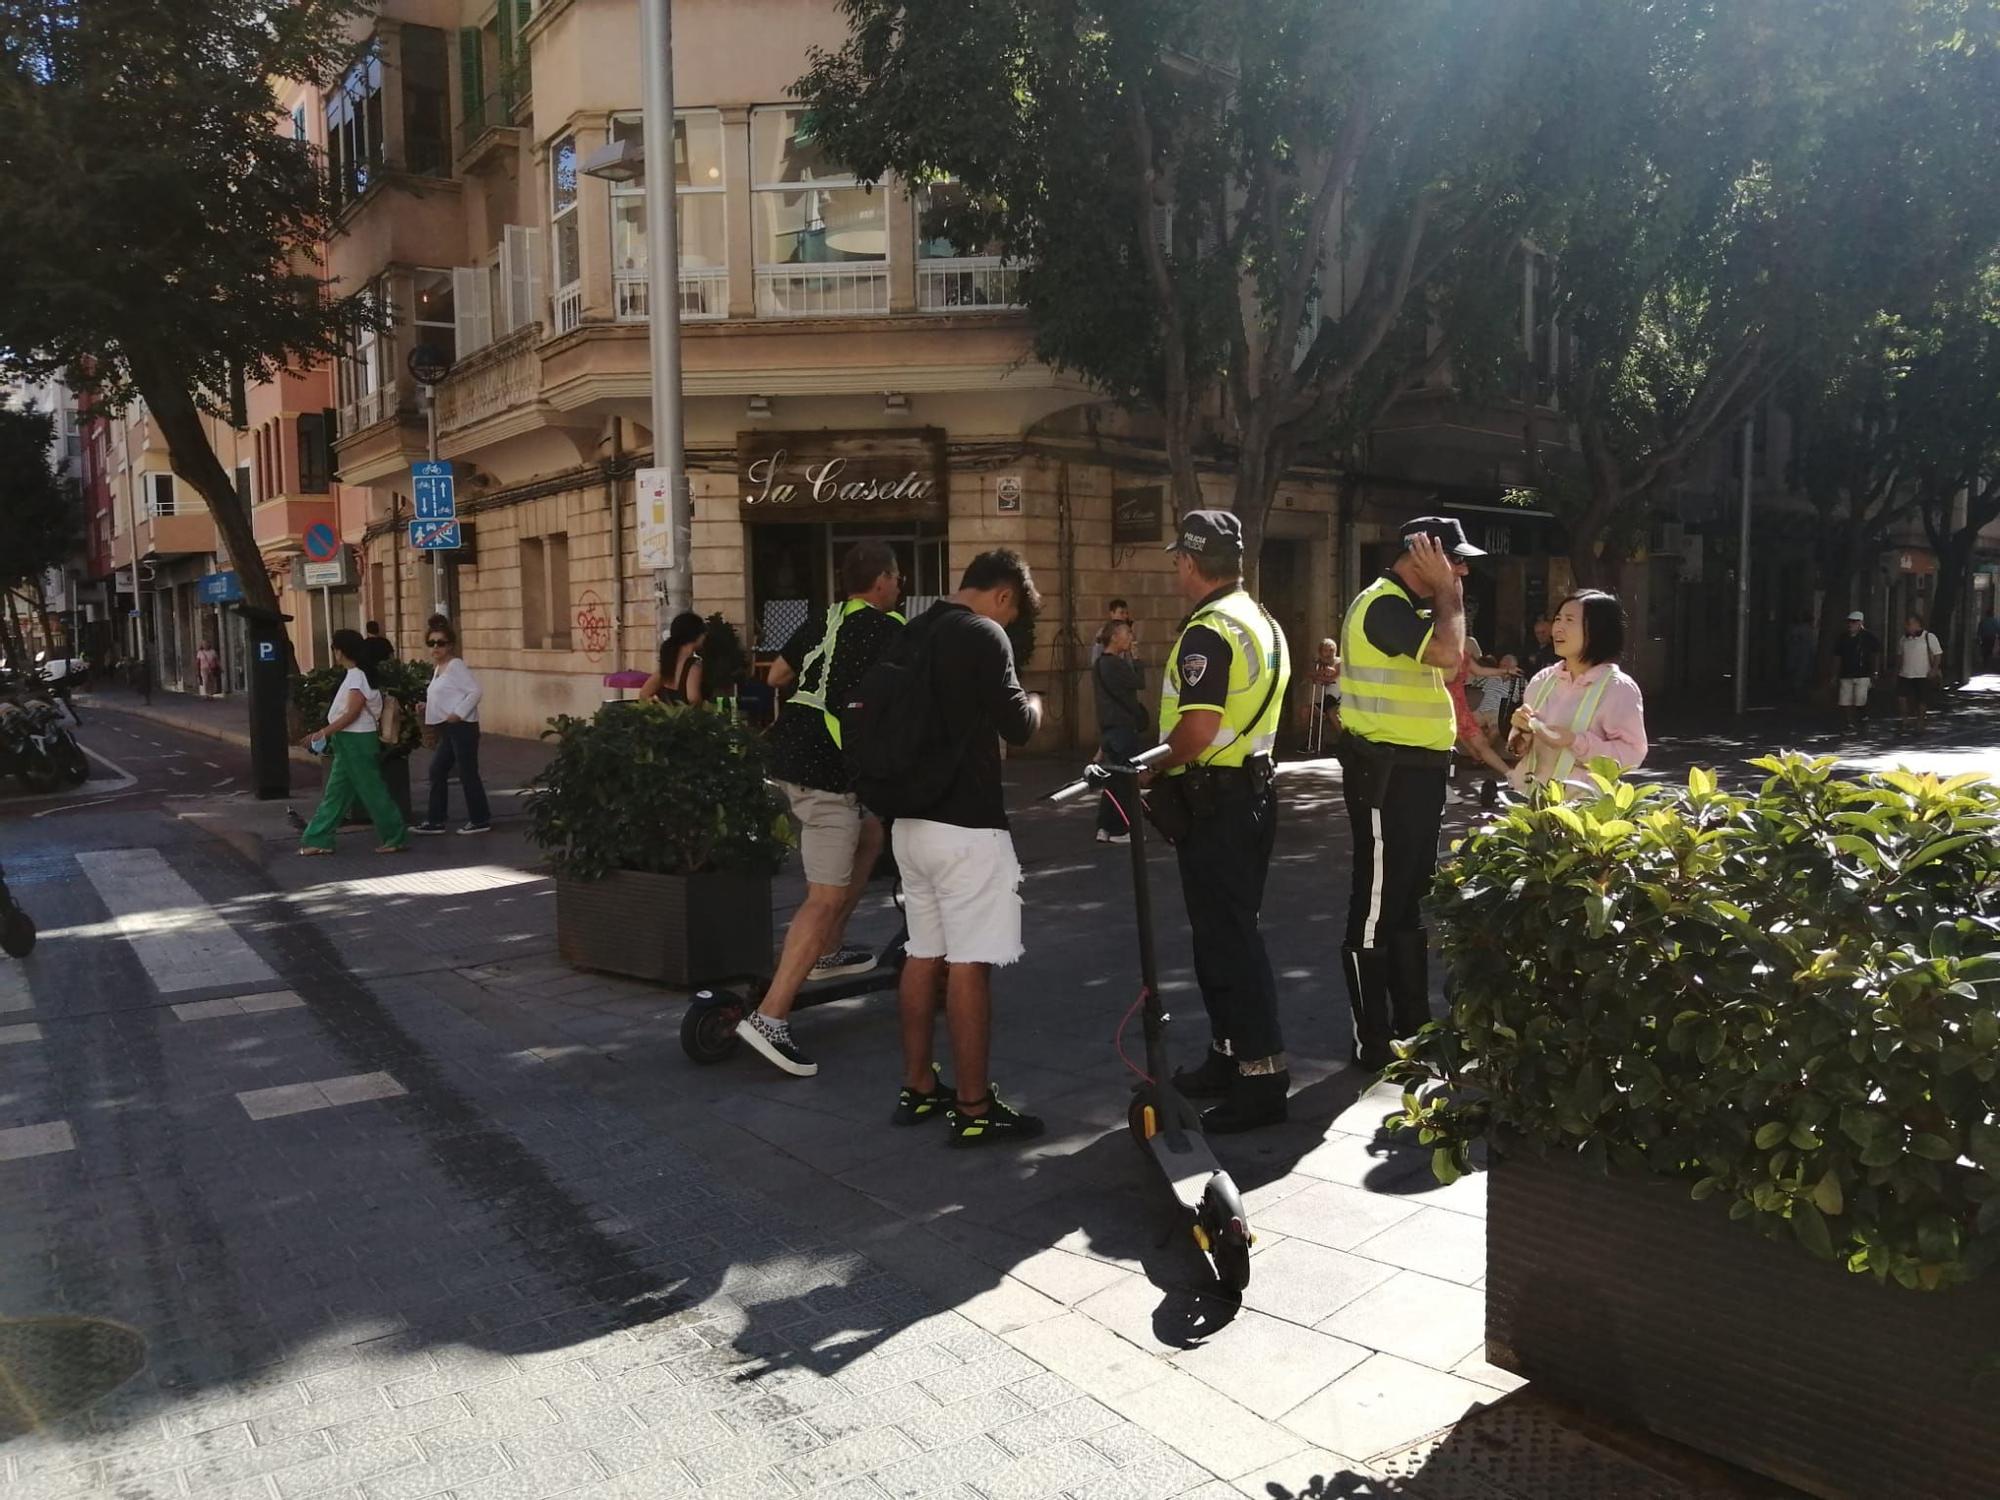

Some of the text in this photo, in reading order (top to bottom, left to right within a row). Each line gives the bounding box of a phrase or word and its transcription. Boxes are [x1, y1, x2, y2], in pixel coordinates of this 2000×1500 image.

[746, 449, 935, 504] La Caseta
[260, 643, 273, 658] P
